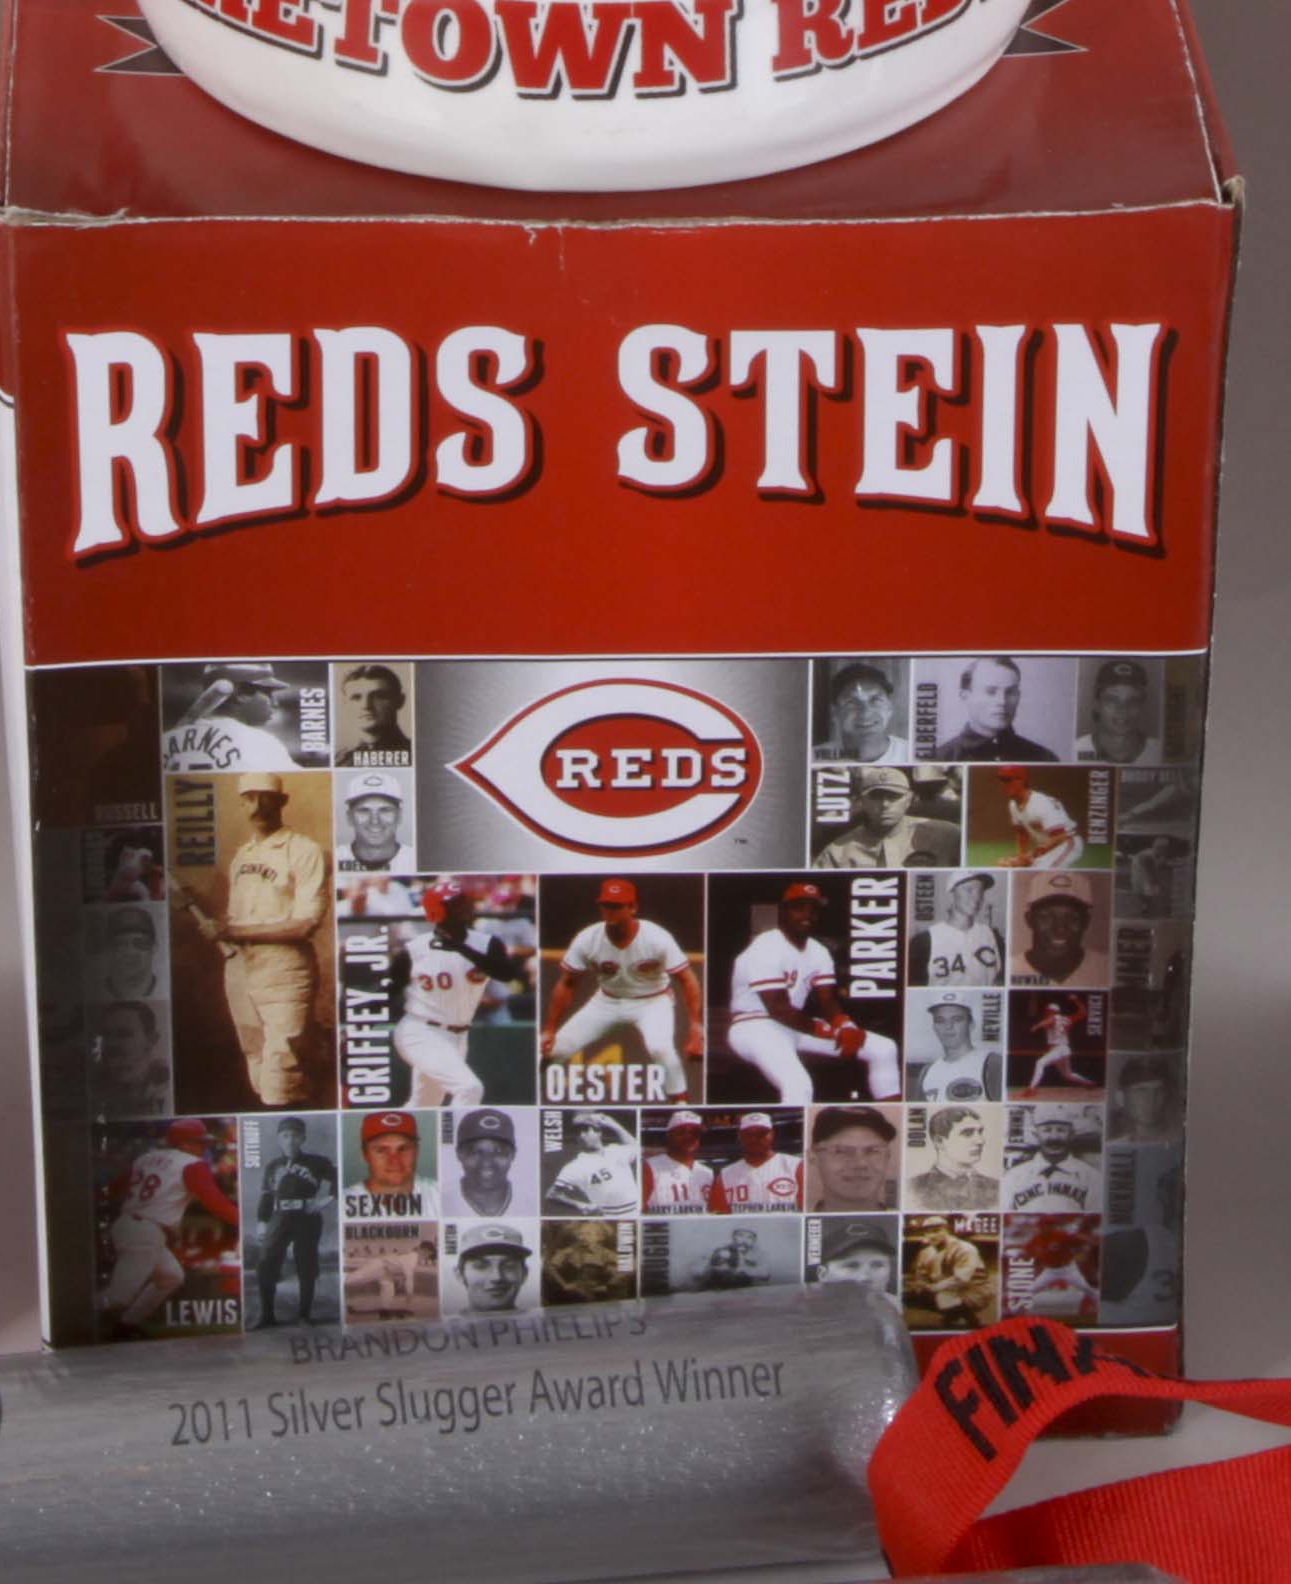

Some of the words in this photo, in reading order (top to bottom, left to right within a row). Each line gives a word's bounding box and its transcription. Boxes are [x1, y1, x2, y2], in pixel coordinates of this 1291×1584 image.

[65, 324, 536, 563] REDS
[616, 321, 1167, 550] STEIN
[299, 687, 327, 753] BARNES
[164, 725, 241, 770] ARNES
[352, 750, 410, 767] HABERER
[555, 747, 748, 790] REDS
[815, 767, 852, 825] LUTZ
[175, 778, 217, 867] REILLY
[345, 923, 390, 972] JR.
[849, 877, 900, 999] PARKER
[417, 971, 452, 993] 30
[932, 955, 967, 979] 34
[544, 1063, 667, 1104] OESTER
[542, 1109, 564, 1153] WELSH
[589, 1167, 612, 1187] 45
[670, 1183, 690, 1203] 11
[344, 1193, 423, 1219] SEXTON
[165, 1297, 239, 1326] LEWIS
[289, 1317, 481, 1366] BRANDON
[489, 1312, 648, 1351] PHILLIPS
[169, 1396, 254, 1447] 2011
[267, 1386, 366, 1439] Silver
[376, 1376, 516, 1435] Slugger
[528, 1366, 647, 1416] Award
[656, 1357, 786, 1405] Winner
